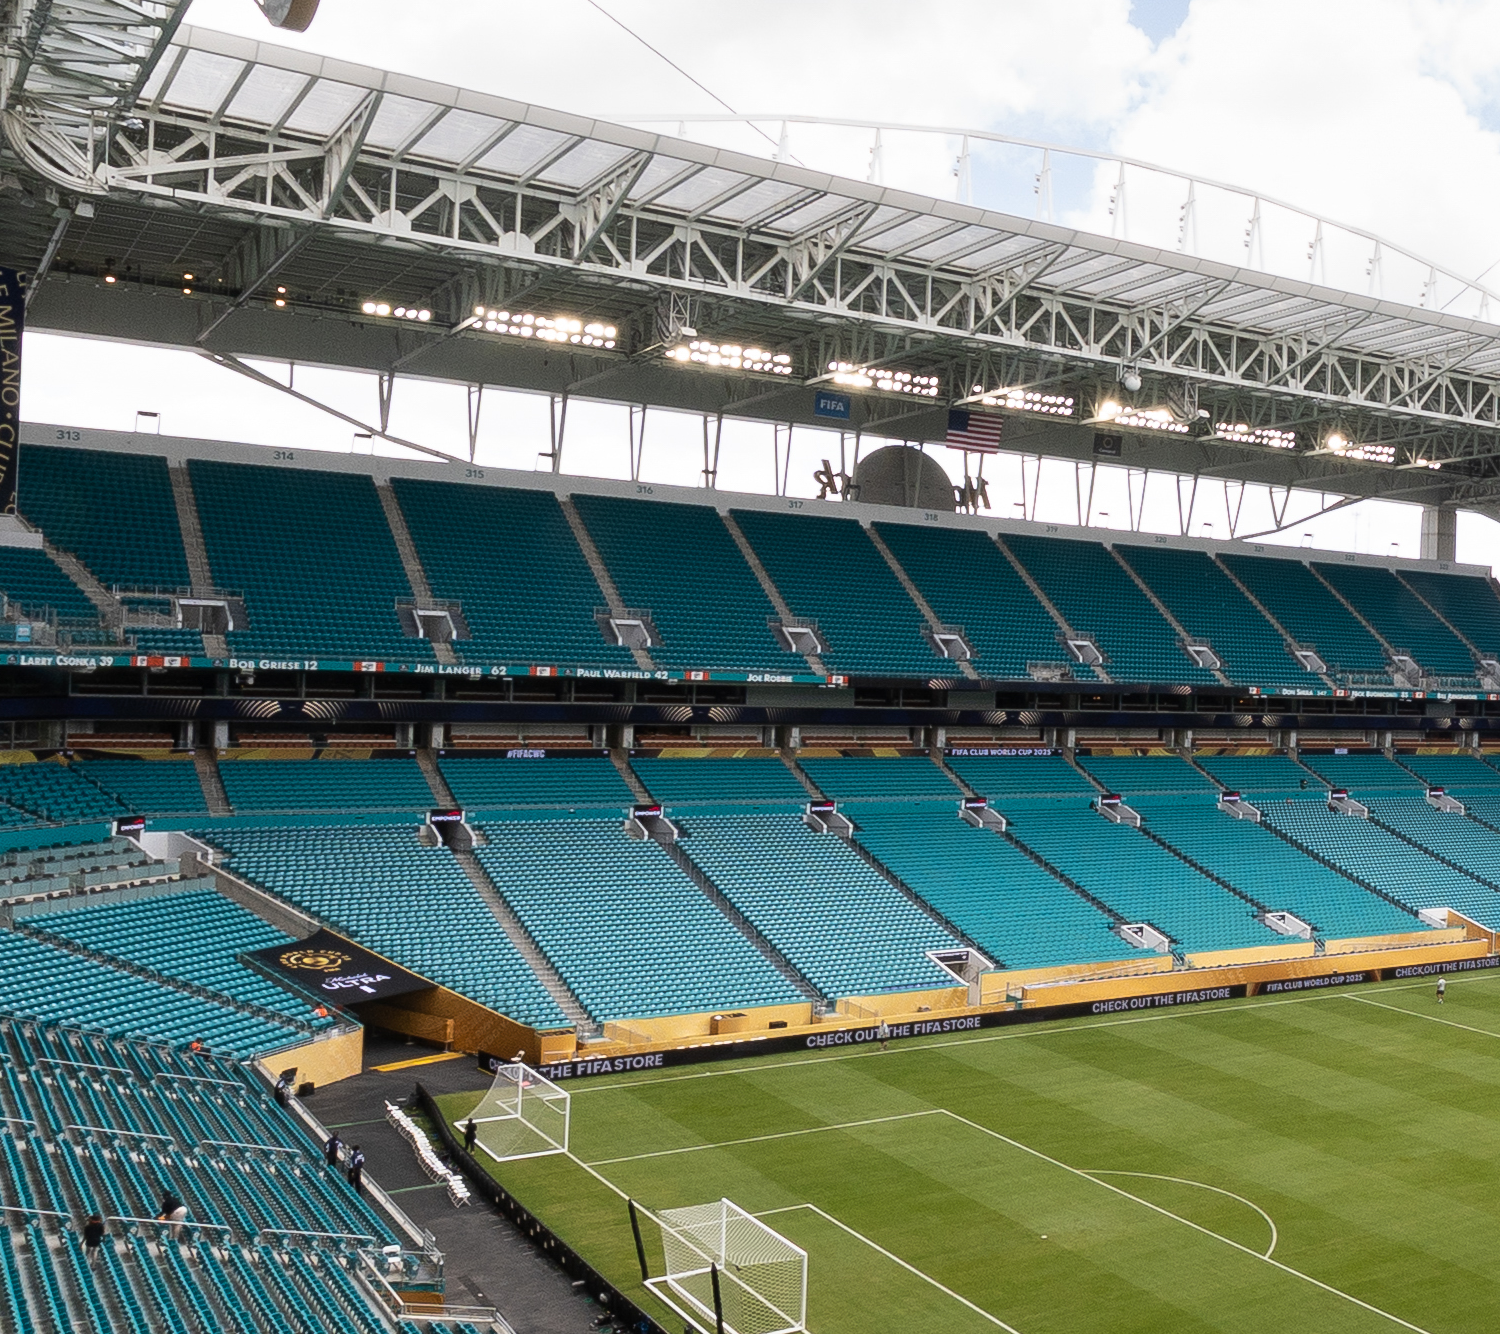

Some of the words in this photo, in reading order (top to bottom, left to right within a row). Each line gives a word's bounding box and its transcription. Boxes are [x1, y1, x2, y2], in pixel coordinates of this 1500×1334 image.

[55, 430, 81, 442] 313
[272, 449, 295, 461] 314
[464, 468, 485, 479] 315
[635, 485, 654, 495] 316
[787, 500, 804, 510] 317
[923, 512, 939, 522] 318
[806, 1030, 853, 1048] CHECK
[855, 1027, 880, 1043] OUT
[884, 1024, 910, 1038] THE
[913, 1021, 941, 1035] FIFA
[940, 1016, 981, 1032] STORE
